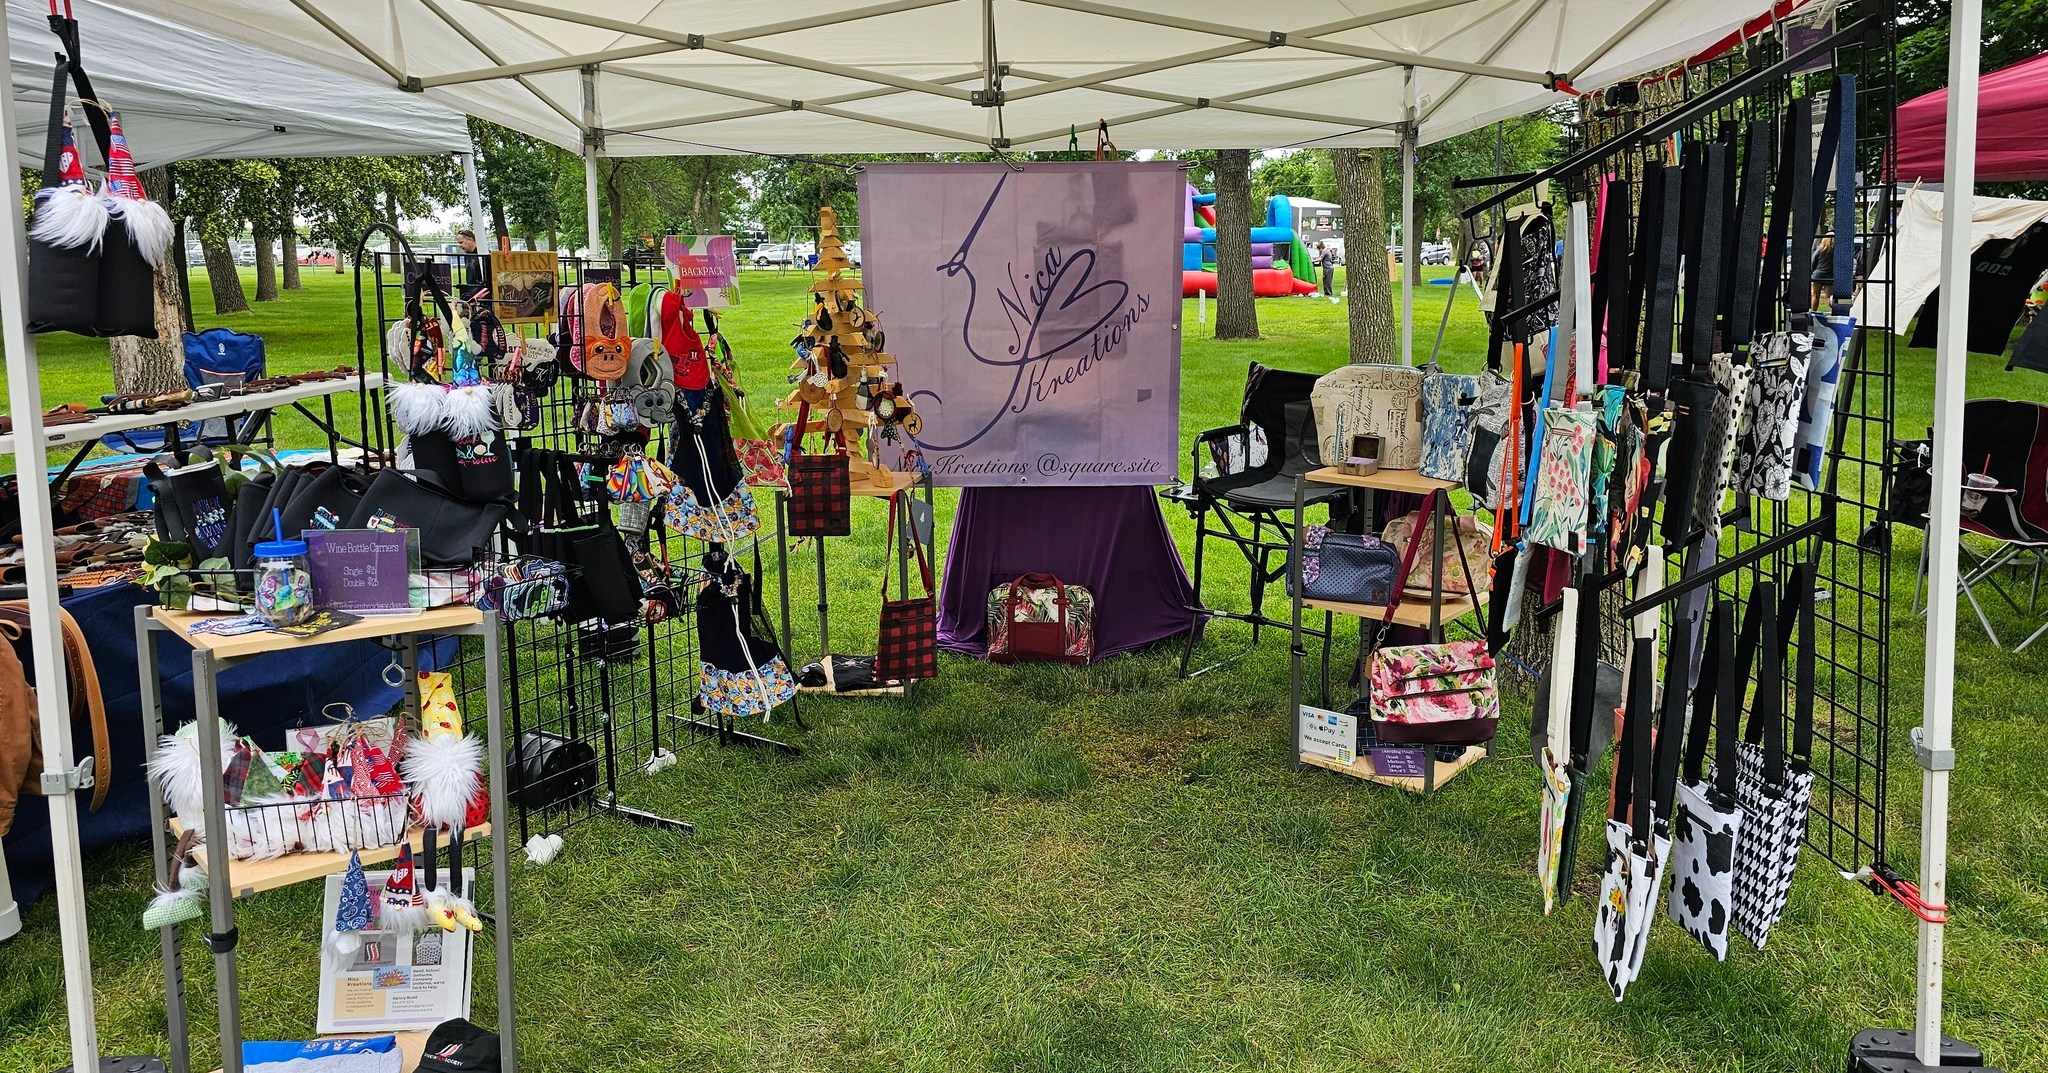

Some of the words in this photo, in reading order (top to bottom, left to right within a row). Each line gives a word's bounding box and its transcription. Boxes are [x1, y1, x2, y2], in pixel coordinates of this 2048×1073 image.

[681, 266, 725, 277] BACKPACK
[997, 246, 1062, 355] Nica
[1011, 293, 1150, 413] Kreations
[1037, 452, 1162, 481] @square.site
[326, 542, 347, 554] Wine
[347, 542, 370, 554] Bottle
[343, 566, 362, 577] Single
[343, 578, 365, 588] Double
[1302, 711, 1315, 719] VISA
[1323, 725, 1335, 735] Pay
[1313, 738, 1331, 746] accept
[1331, 741, 1347, 749] Cards
